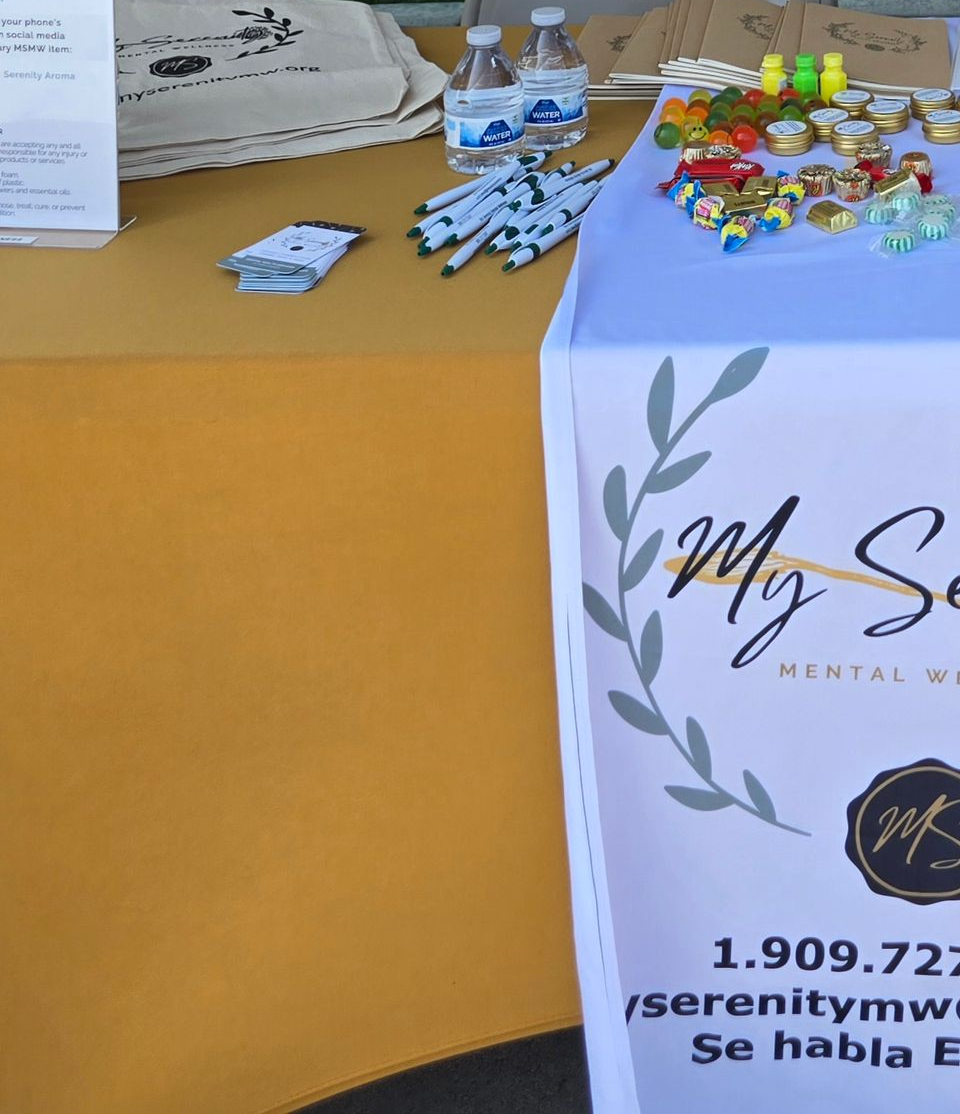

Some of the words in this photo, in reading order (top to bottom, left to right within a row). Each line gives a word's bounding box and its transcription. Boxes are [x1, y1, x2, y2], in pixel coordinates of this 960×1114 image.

[24, 18, 62, 27] phone's
[36, 32, 66, 40] media
[13, 44, 46, 53] MSMW
[3, 70, 42, 81] Serenity
[44, 72, 76, 80] Aroma
[532, 110, 560, 119] WATER
[482, 130, 511, 143] WATER
[667, 495, 828, 669] My
[779, 662, 905, 683] MENTAL
[691, 1032, 754, 1065] Se
[774, 1031, 914, 1070] habla
